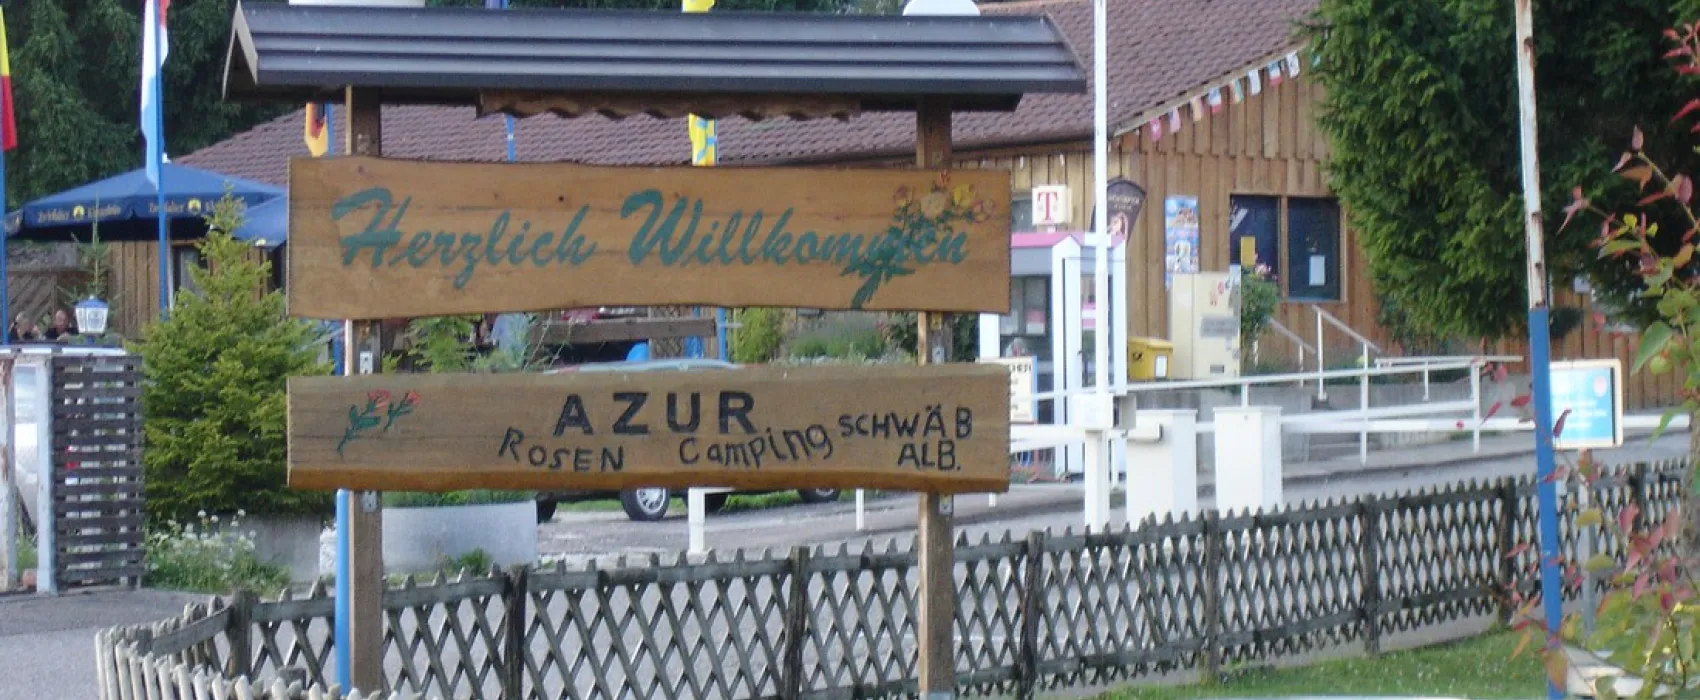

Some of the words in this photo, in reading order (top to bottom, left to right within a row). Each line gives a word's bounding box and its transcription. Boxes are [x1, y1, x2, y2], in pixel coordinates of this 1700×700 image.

[331, 187, 597, 289] Herzlich
[498, 427, 624, 472] ROSEN
[679, 424, 834, 468] Camping
[838, 402, 973, 439] SCHWÄB
[553, 390, 757, 437] AZUR
[897, 440, 961, 471] ALB.
